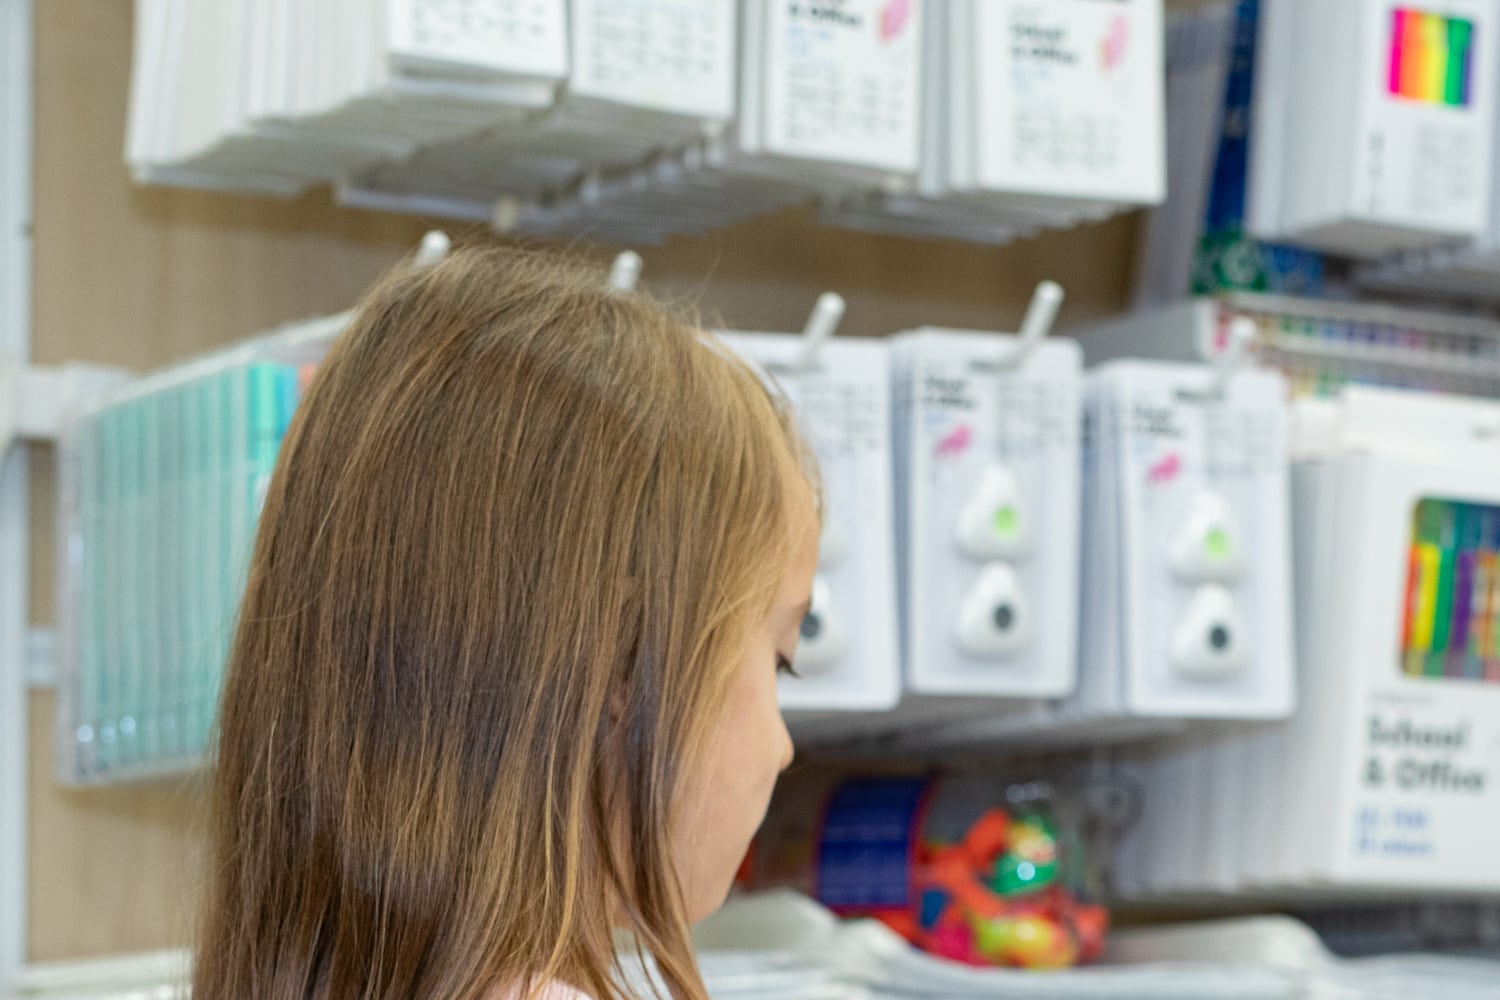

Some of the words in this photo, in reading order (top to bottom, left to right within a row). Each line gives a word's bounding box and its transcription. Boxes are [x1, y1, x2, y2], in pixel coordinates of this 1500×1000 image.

[1367, 714, 1472, 750] School
[1362, 756, 1385, 787] &
[1394, 756, 1488, 795] Office
